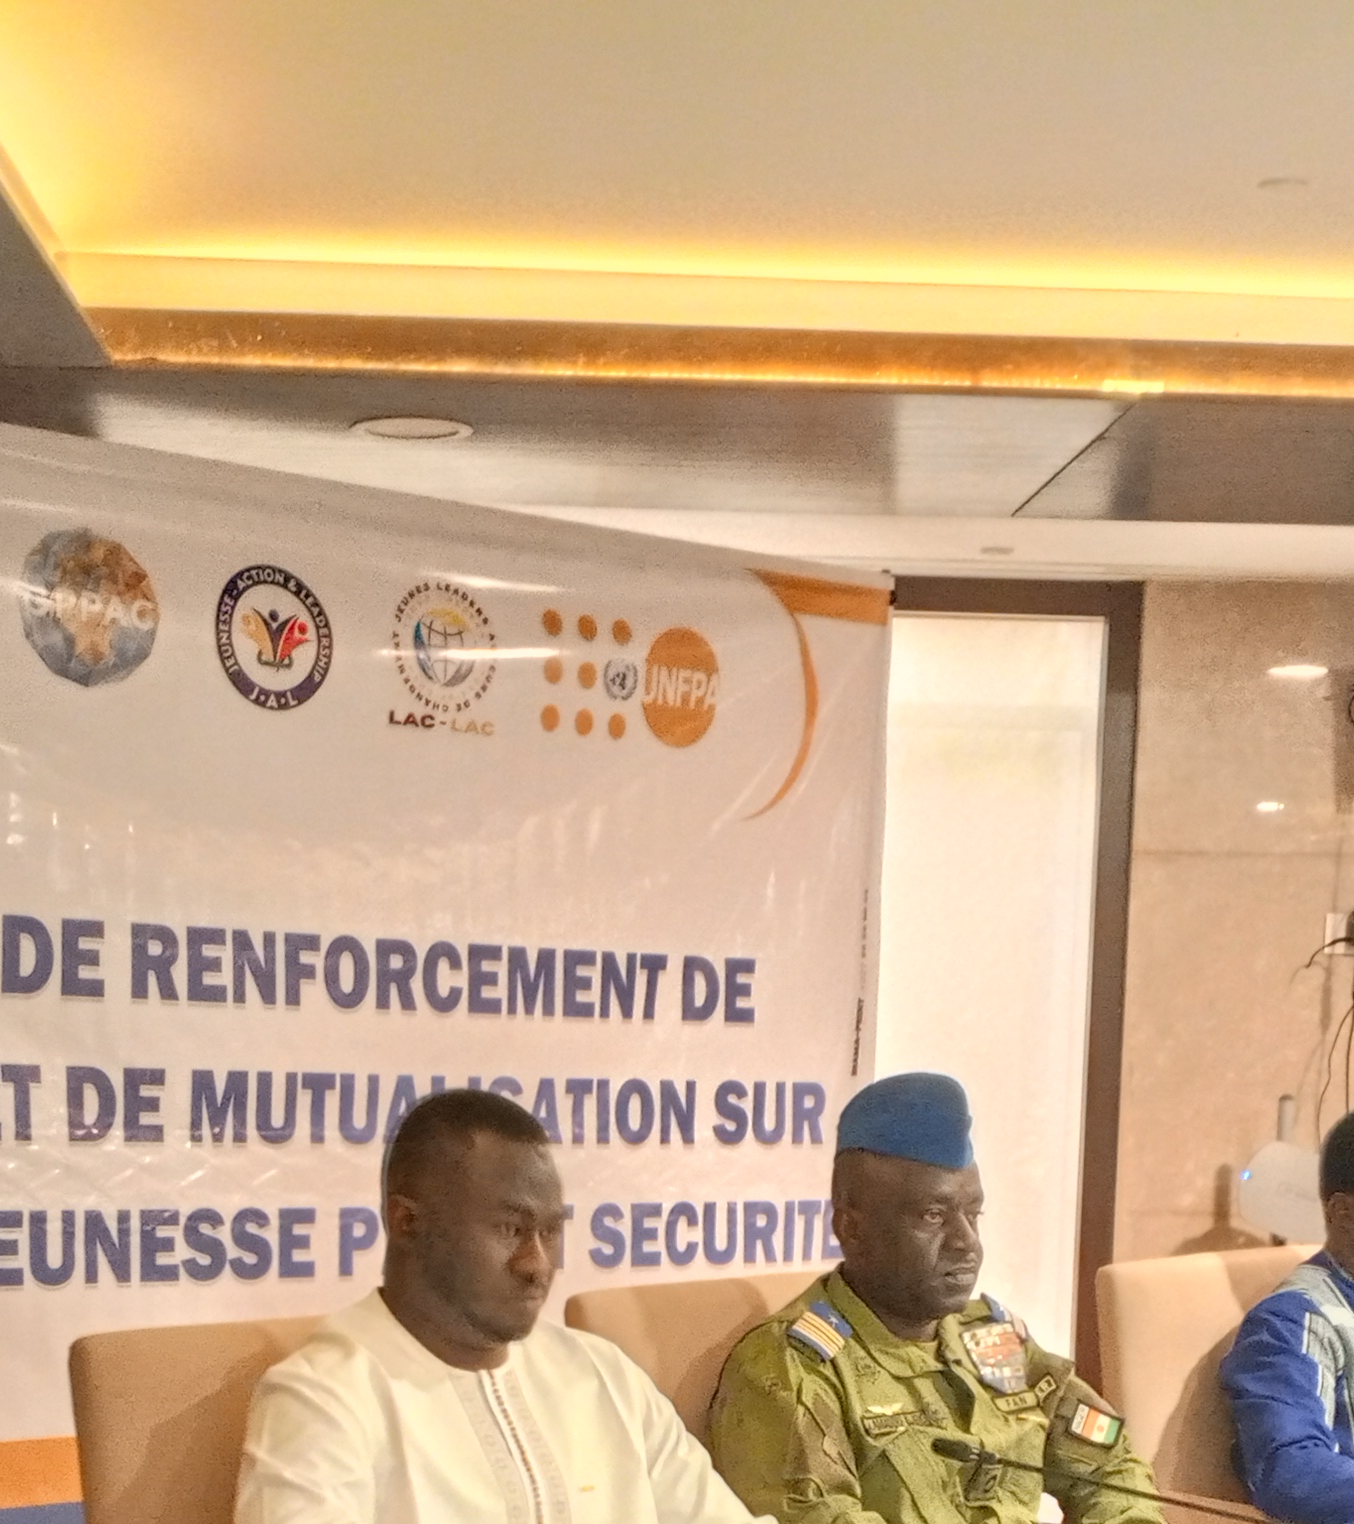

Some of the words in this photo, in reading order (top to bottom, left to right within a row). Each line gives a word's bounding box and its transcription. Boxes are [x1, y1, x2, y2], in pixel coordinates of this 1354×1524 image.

[300, 589, 331, 682] LEADERSHIP
[0, 914, 106, 998] DE
[129, 921, 668, 1021] RENFORCEMENT
[680, 954, 757, 1024] DE
[65, 1065, 166, 1144] DE
[189, 1069, 698, 1146] MUTUAATION
[711, 1078, 827, 1146] SUR
